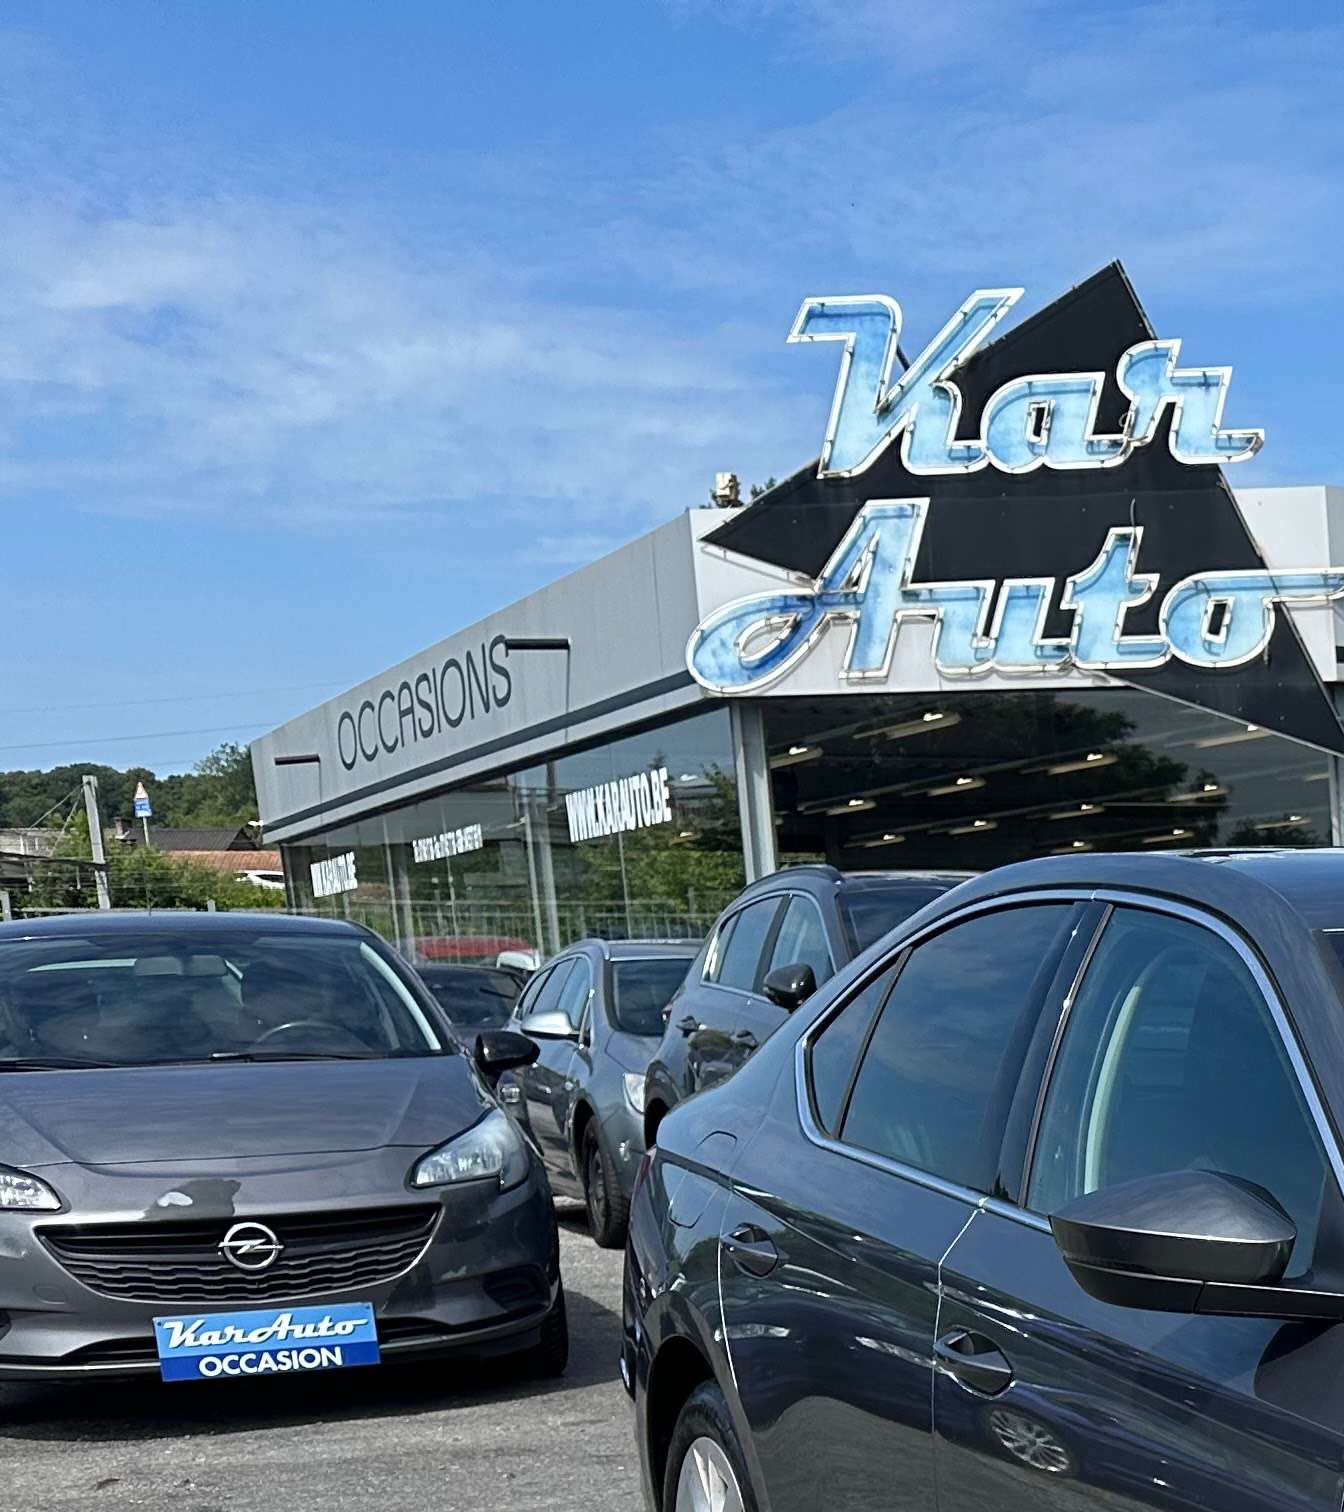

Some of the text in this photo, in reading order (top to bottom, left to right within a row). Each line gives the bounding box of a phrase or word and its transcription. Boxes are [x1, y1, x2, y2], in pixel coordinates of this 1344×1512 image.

[787, 287, 1265, 479] Kar
[337, 633, 513, 772] OCCASIONS
[565, 766, 673, 843] WWW.KARAUTO.BE
[198, 1346, 344, 1378] OCCASION
